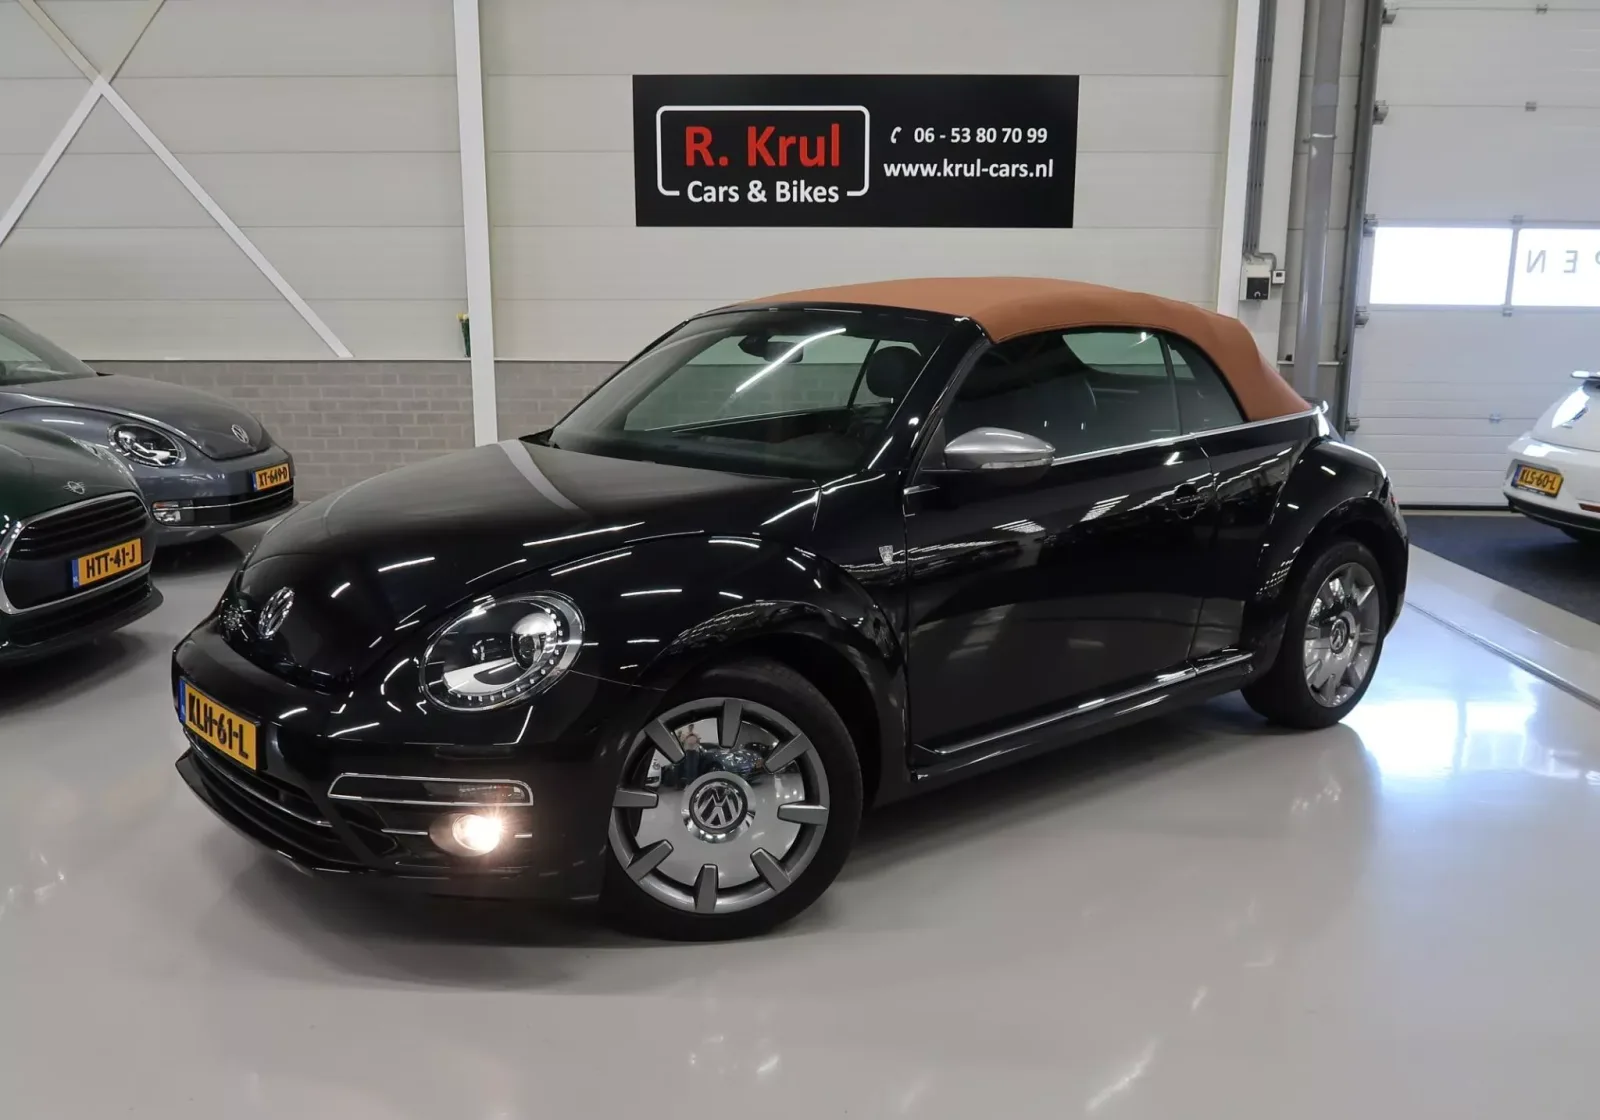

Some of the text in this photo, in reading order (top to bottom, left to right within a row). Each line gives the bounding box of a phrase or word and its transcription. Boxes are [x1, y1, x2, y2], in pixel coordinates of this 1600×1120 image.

[685, 123, 840, 167] R. Krul
[913, 127, 935, 143] 06
[950, 127, 972, 143] 53
[975, 127, 997, 143] 80
[1001, 127, 1023, 143] 70
[1026, 127, 1048, 143] 99
[883, 158, 1054, 178] www.krul-cars.nl
[686, 180, 840, 203] Cars & Bikes
[258, 466, 288, 487] XT-649-D
[1519, 469, 1557, 491] KLS-60-L
[86, 543, 136, 579] HTT-41-J
[188, 692, 249, 760] KLH-61-L
